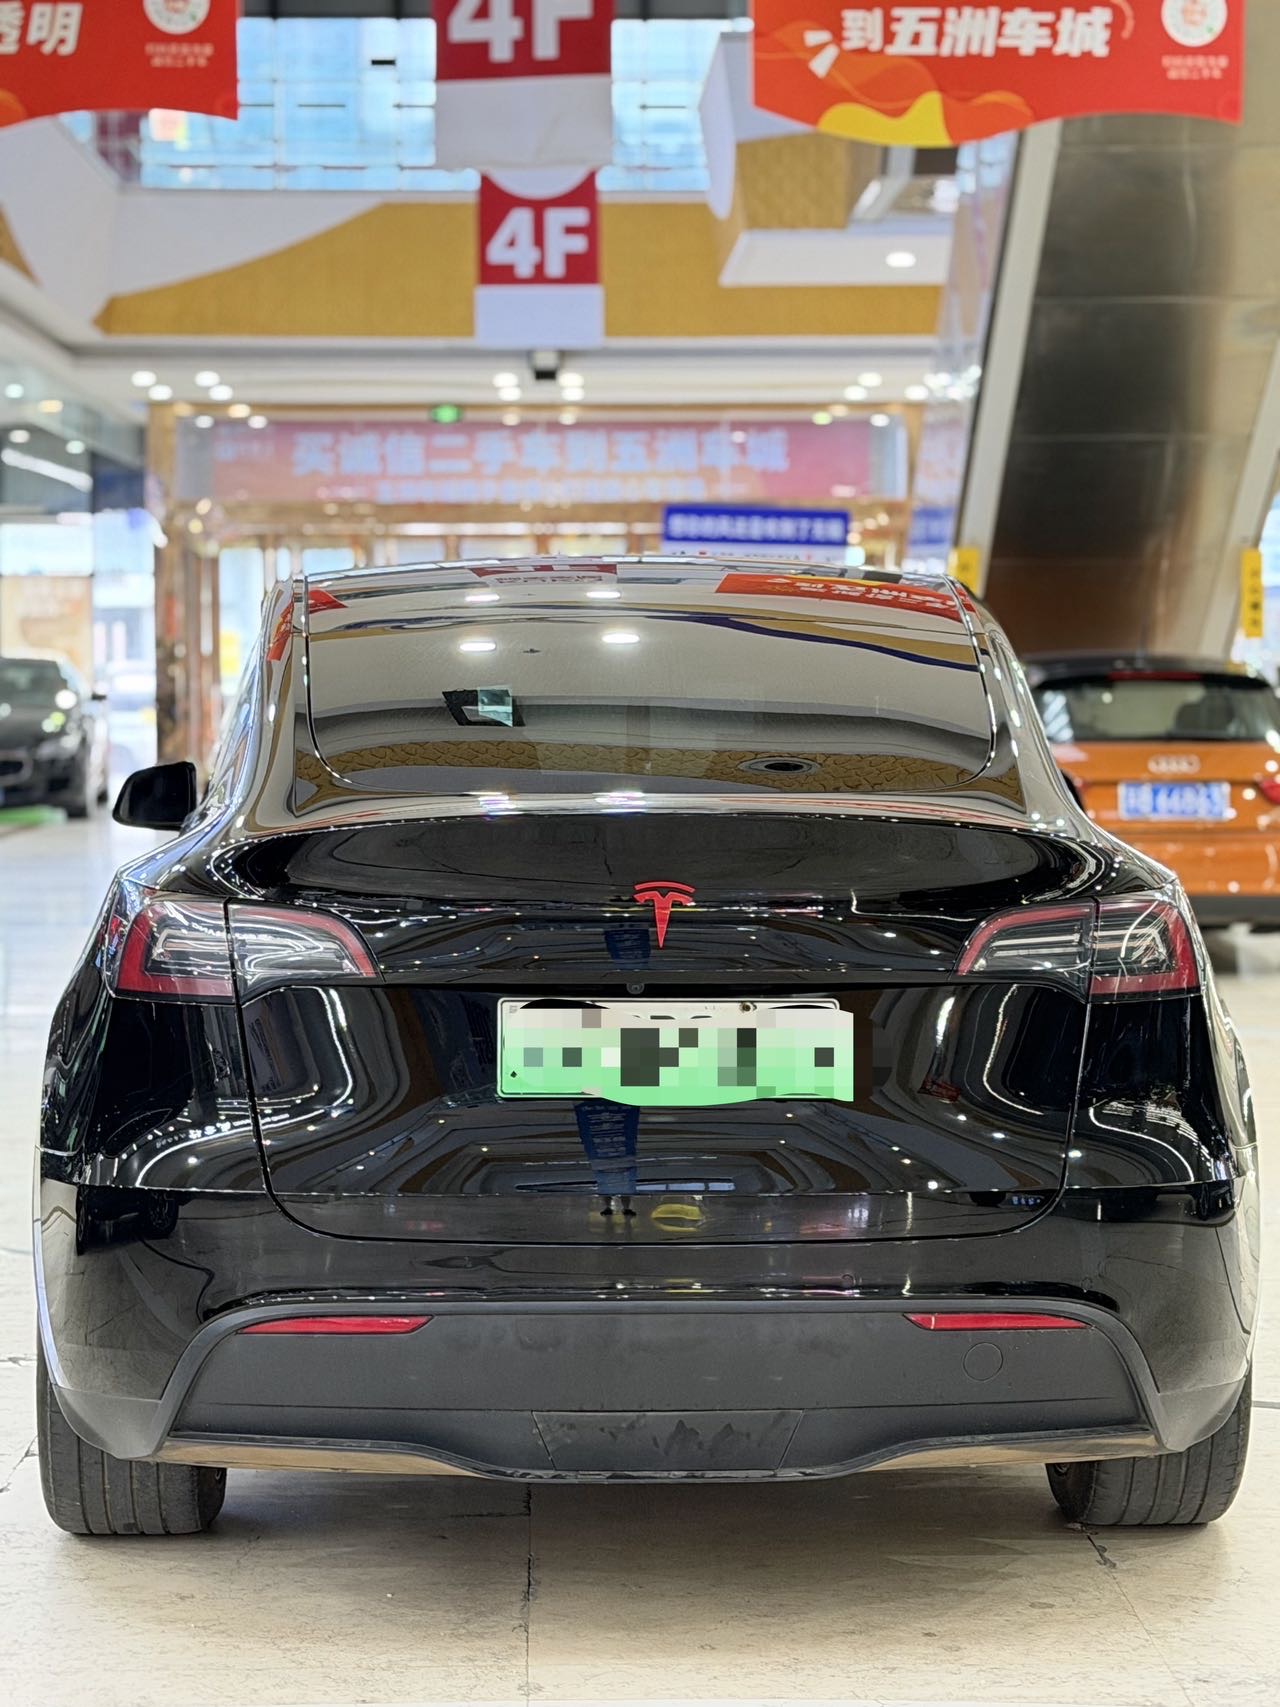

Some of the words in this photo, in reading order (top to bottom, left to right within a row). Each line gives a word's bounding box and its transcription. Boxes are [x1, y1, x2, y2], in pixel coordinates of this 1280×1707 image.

[841, 6, 1113, 57] 到五洲车城
[486, 207, 589, 279] 4F
